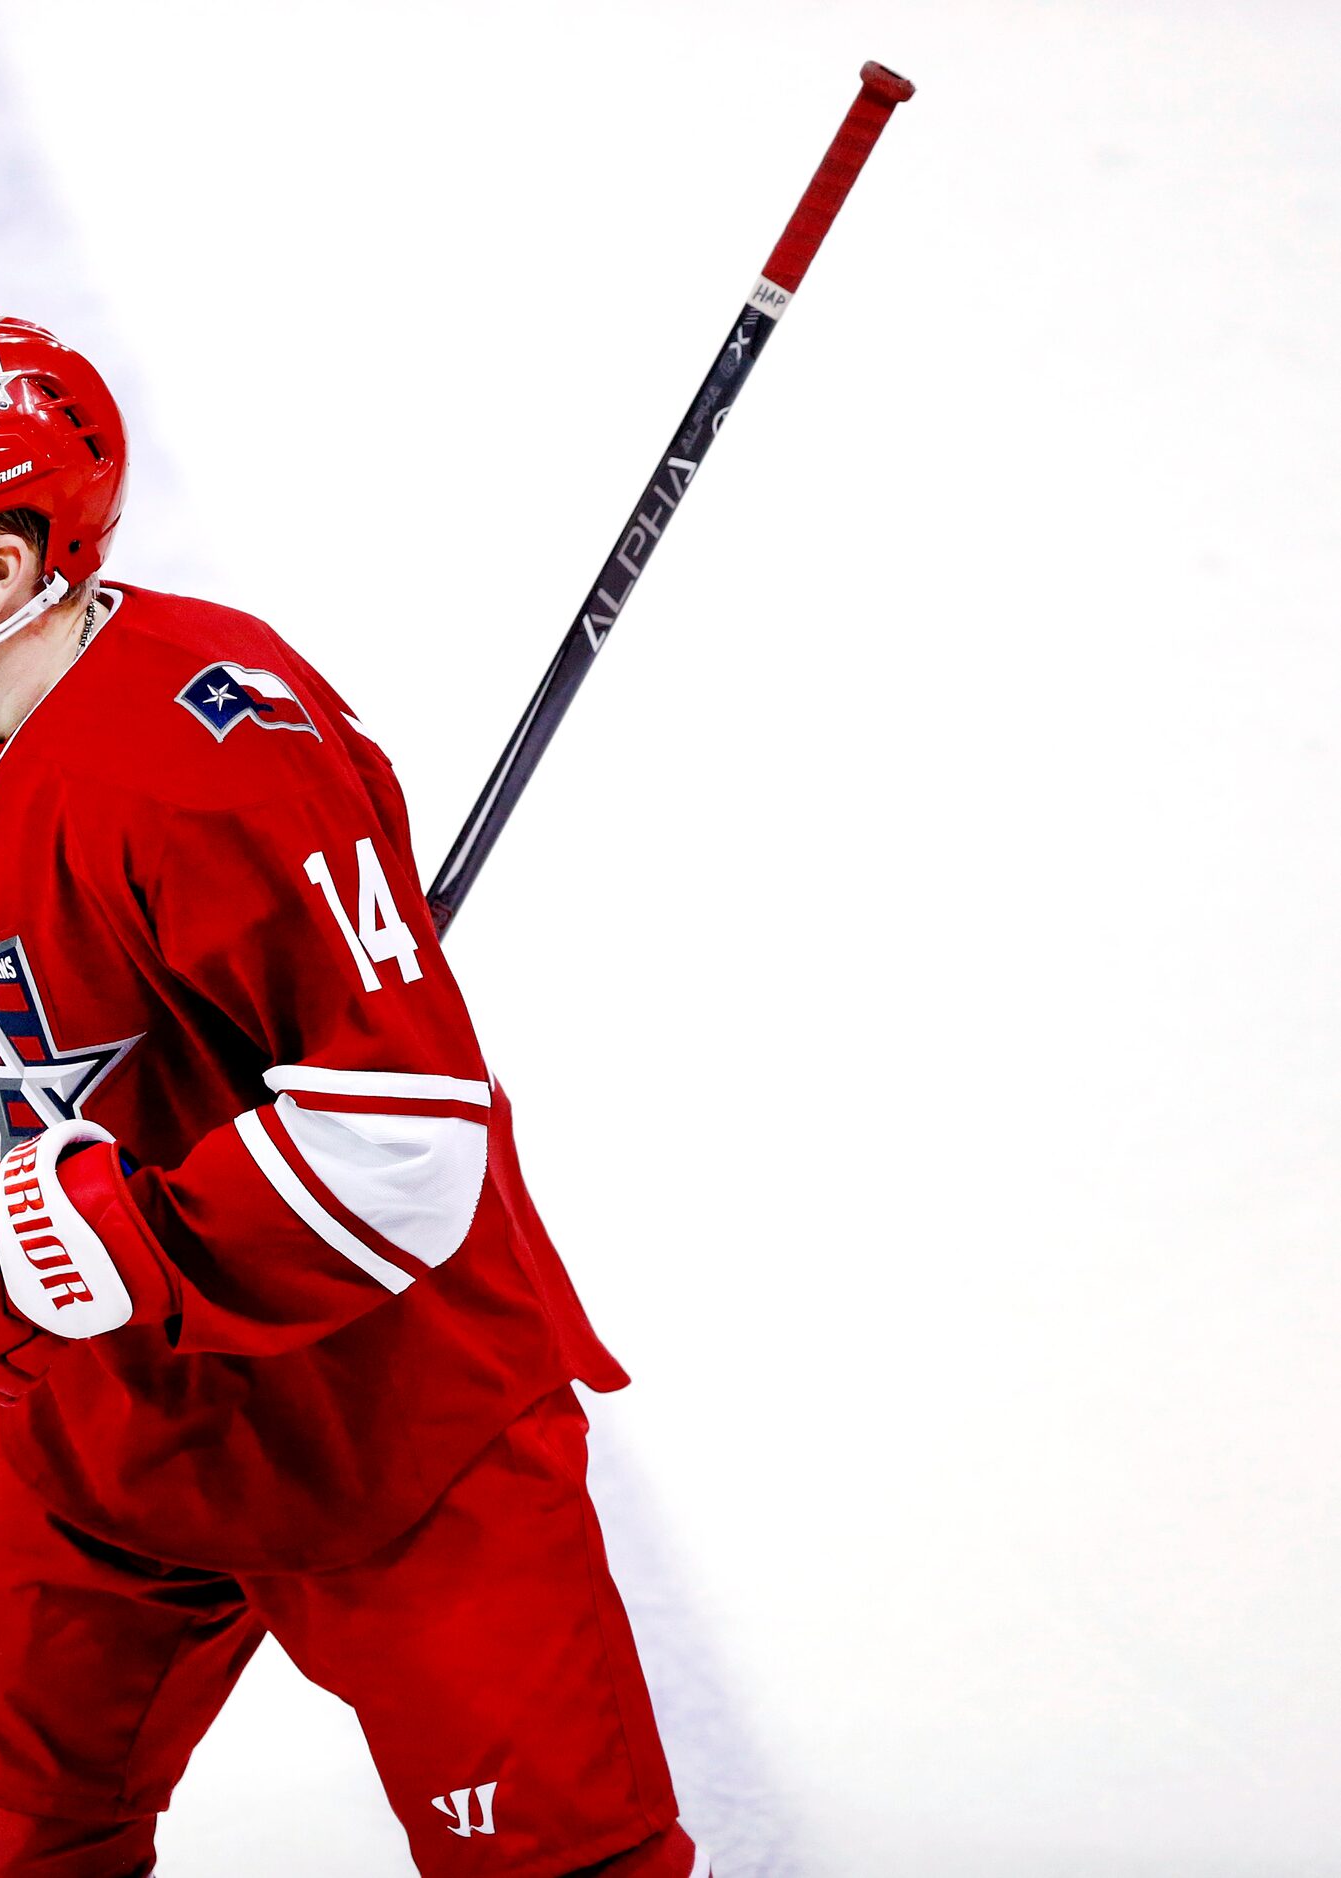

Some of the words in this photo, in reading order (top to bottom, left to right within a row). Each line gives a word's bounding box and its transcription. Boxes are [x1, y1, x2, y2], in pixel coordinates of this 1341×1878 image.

[752, 283, 786, 308] HAP
[581, 456, 698, 653] ALPHA
[303, 837, 424, 993] 14
